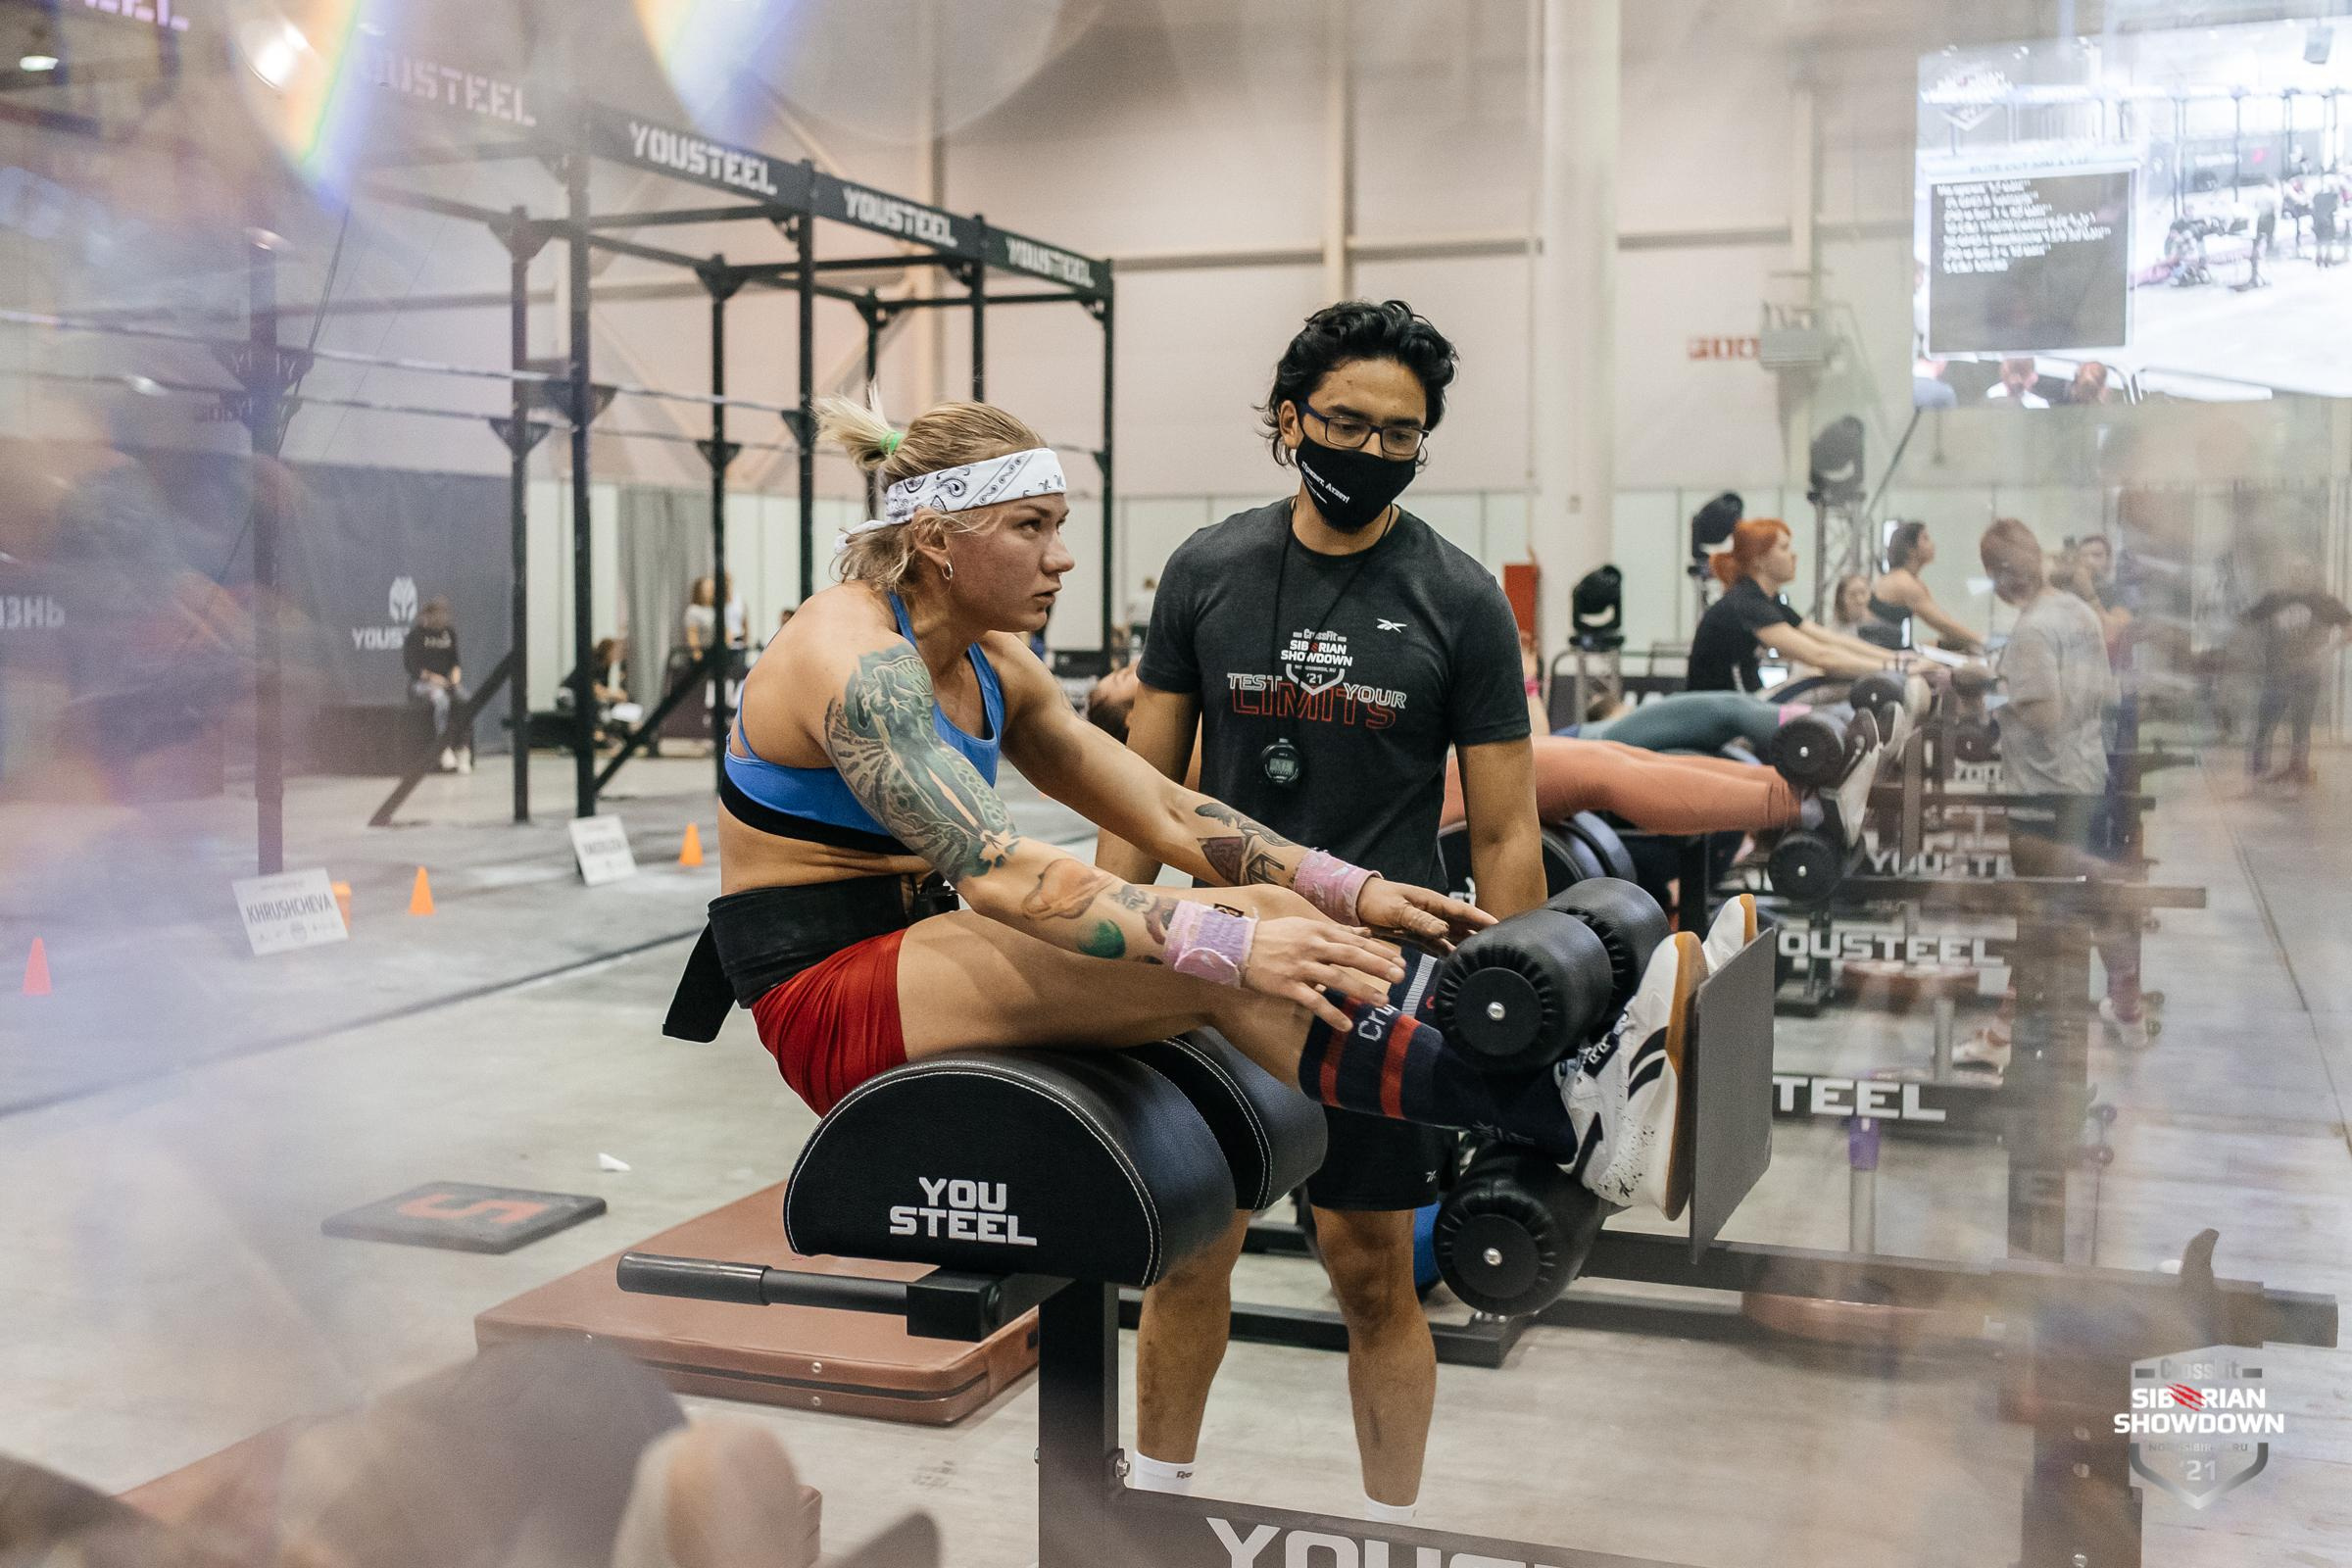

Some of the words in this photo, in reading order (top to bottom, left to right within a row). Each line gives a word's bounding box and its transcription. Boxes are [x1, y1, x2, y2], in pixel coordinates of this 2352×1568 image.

[382, 53, 537, 127] USTEEL
[627, 121, 779, 196] YOUSTEEL
[842, 185, 958, 249] YOUSTEEL
[0, 596, 66, 629] ЗНЬ
[352, 626, 411, 649] YOUS
[1280, 649, 1353, 667] SHOWDOWN
[1227, 672, 1283, 692] TEST
[1343, 682, 1407, 710] YOUR
[1232, 679, 1396, 730] LIMITS
[246, 893, 334, 924] KHRUSHCHEVA
[1778, 930, 2005, 965] OUSTEEL
[1773, 1076, 1946, 1122] TEEL
[918, 1176, 1007, 1202] YOU
[889, 1205, 1038, 1247] STEEL
